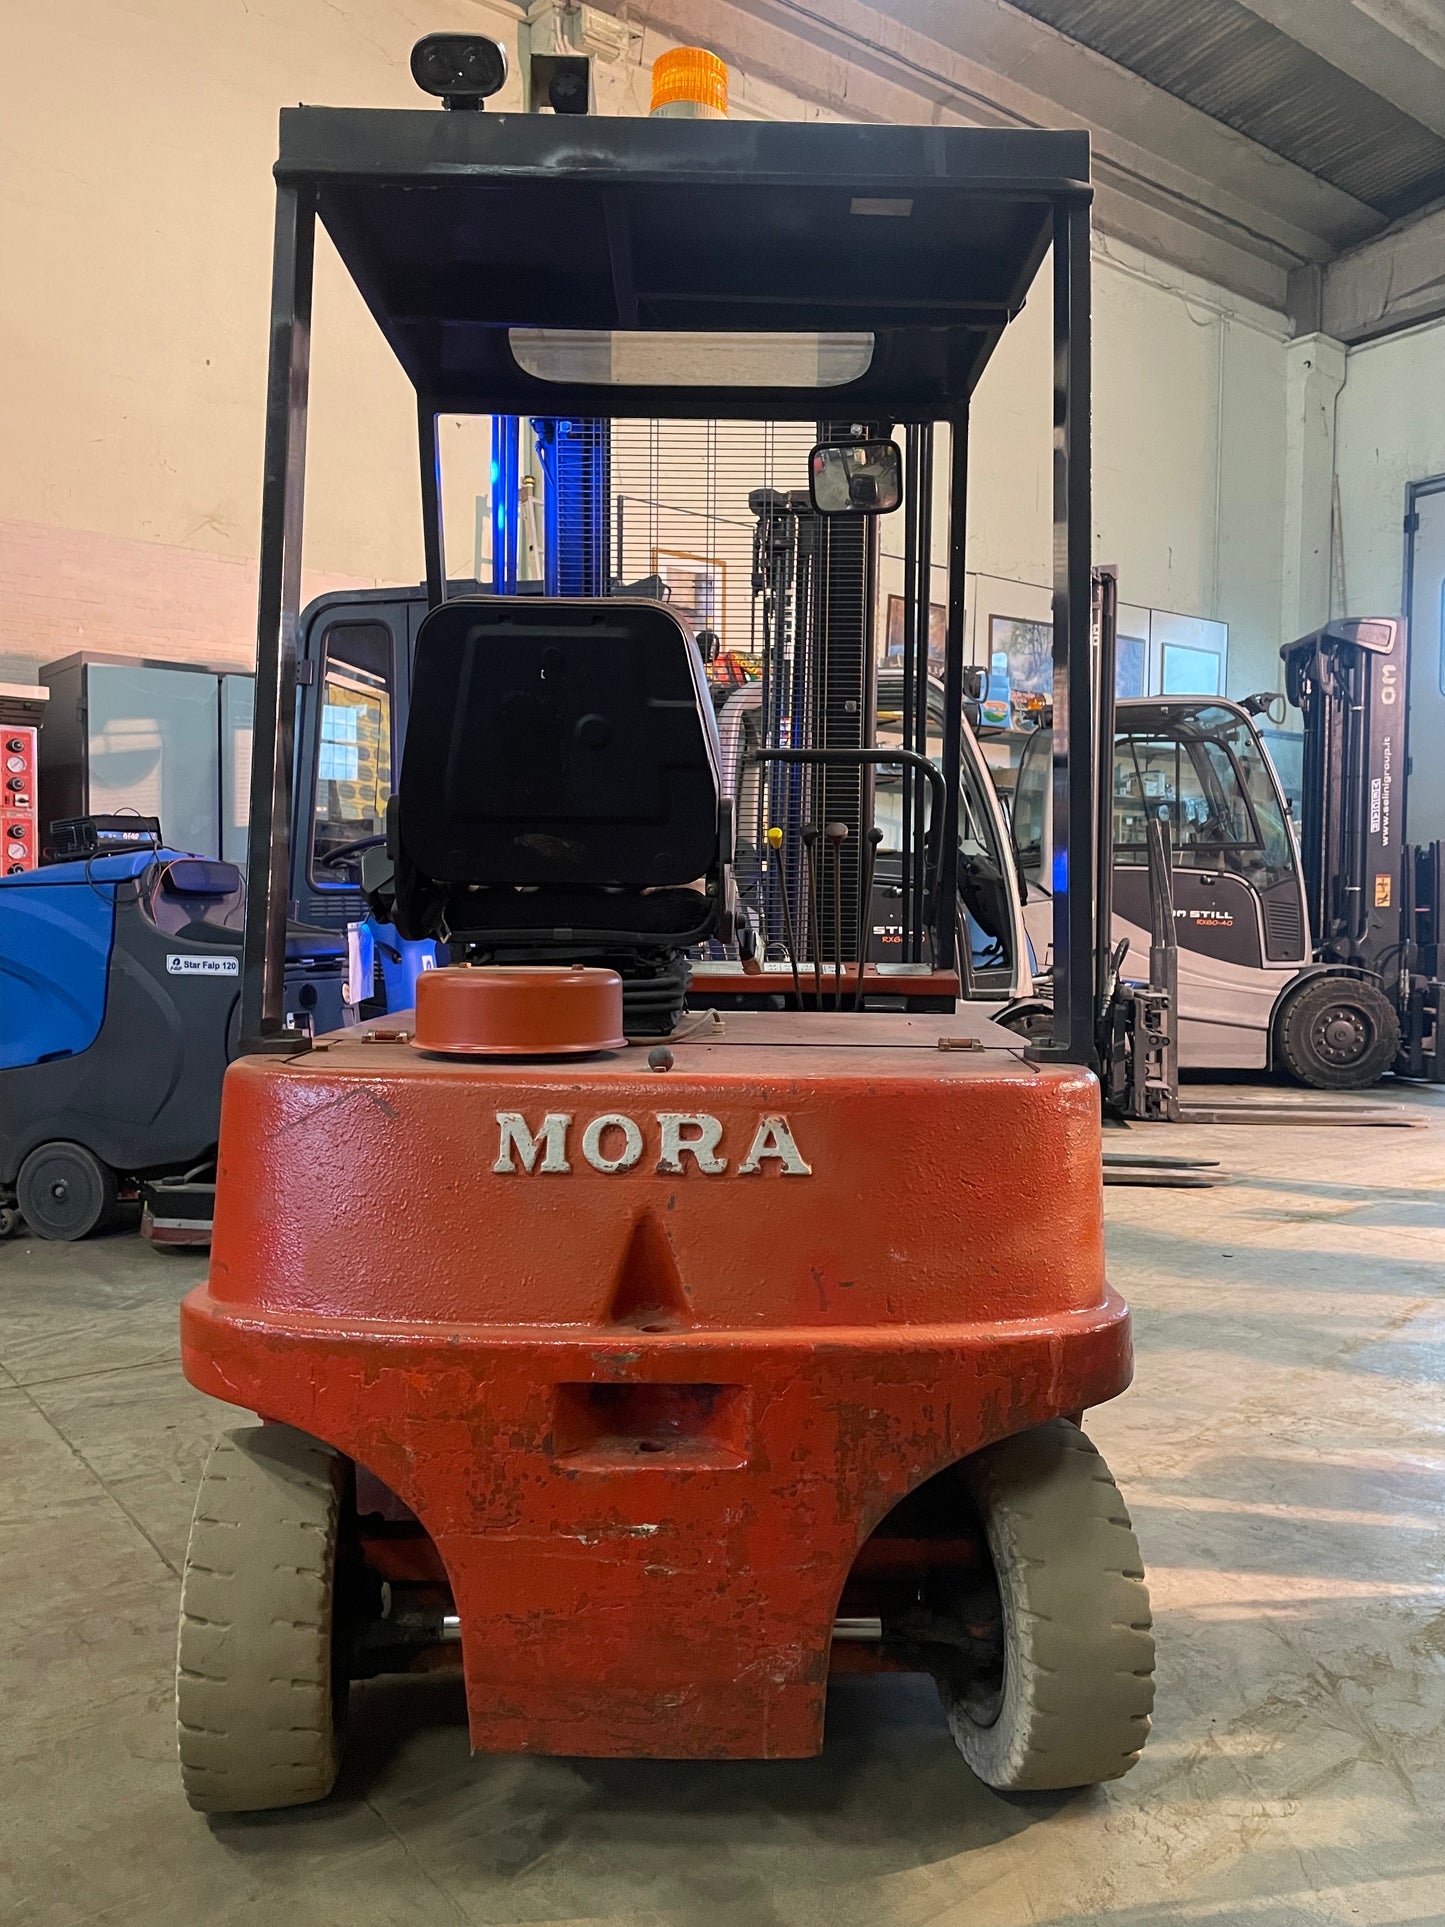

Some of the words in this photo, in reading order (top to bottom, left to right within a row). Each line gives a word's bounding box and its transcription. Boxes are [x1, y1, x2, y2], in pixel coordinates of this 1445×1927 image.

[1382, 664, 1396, 705] OM
[1189, 910, 1234, 919] STILL
[873, 926, 925, 935] STI
[184, 960, 201, 969] Star
[202, 961, 220, 971] Falp
[222, 961, 237, 970] 120
[493, 1113, 812, 1175] MORA
